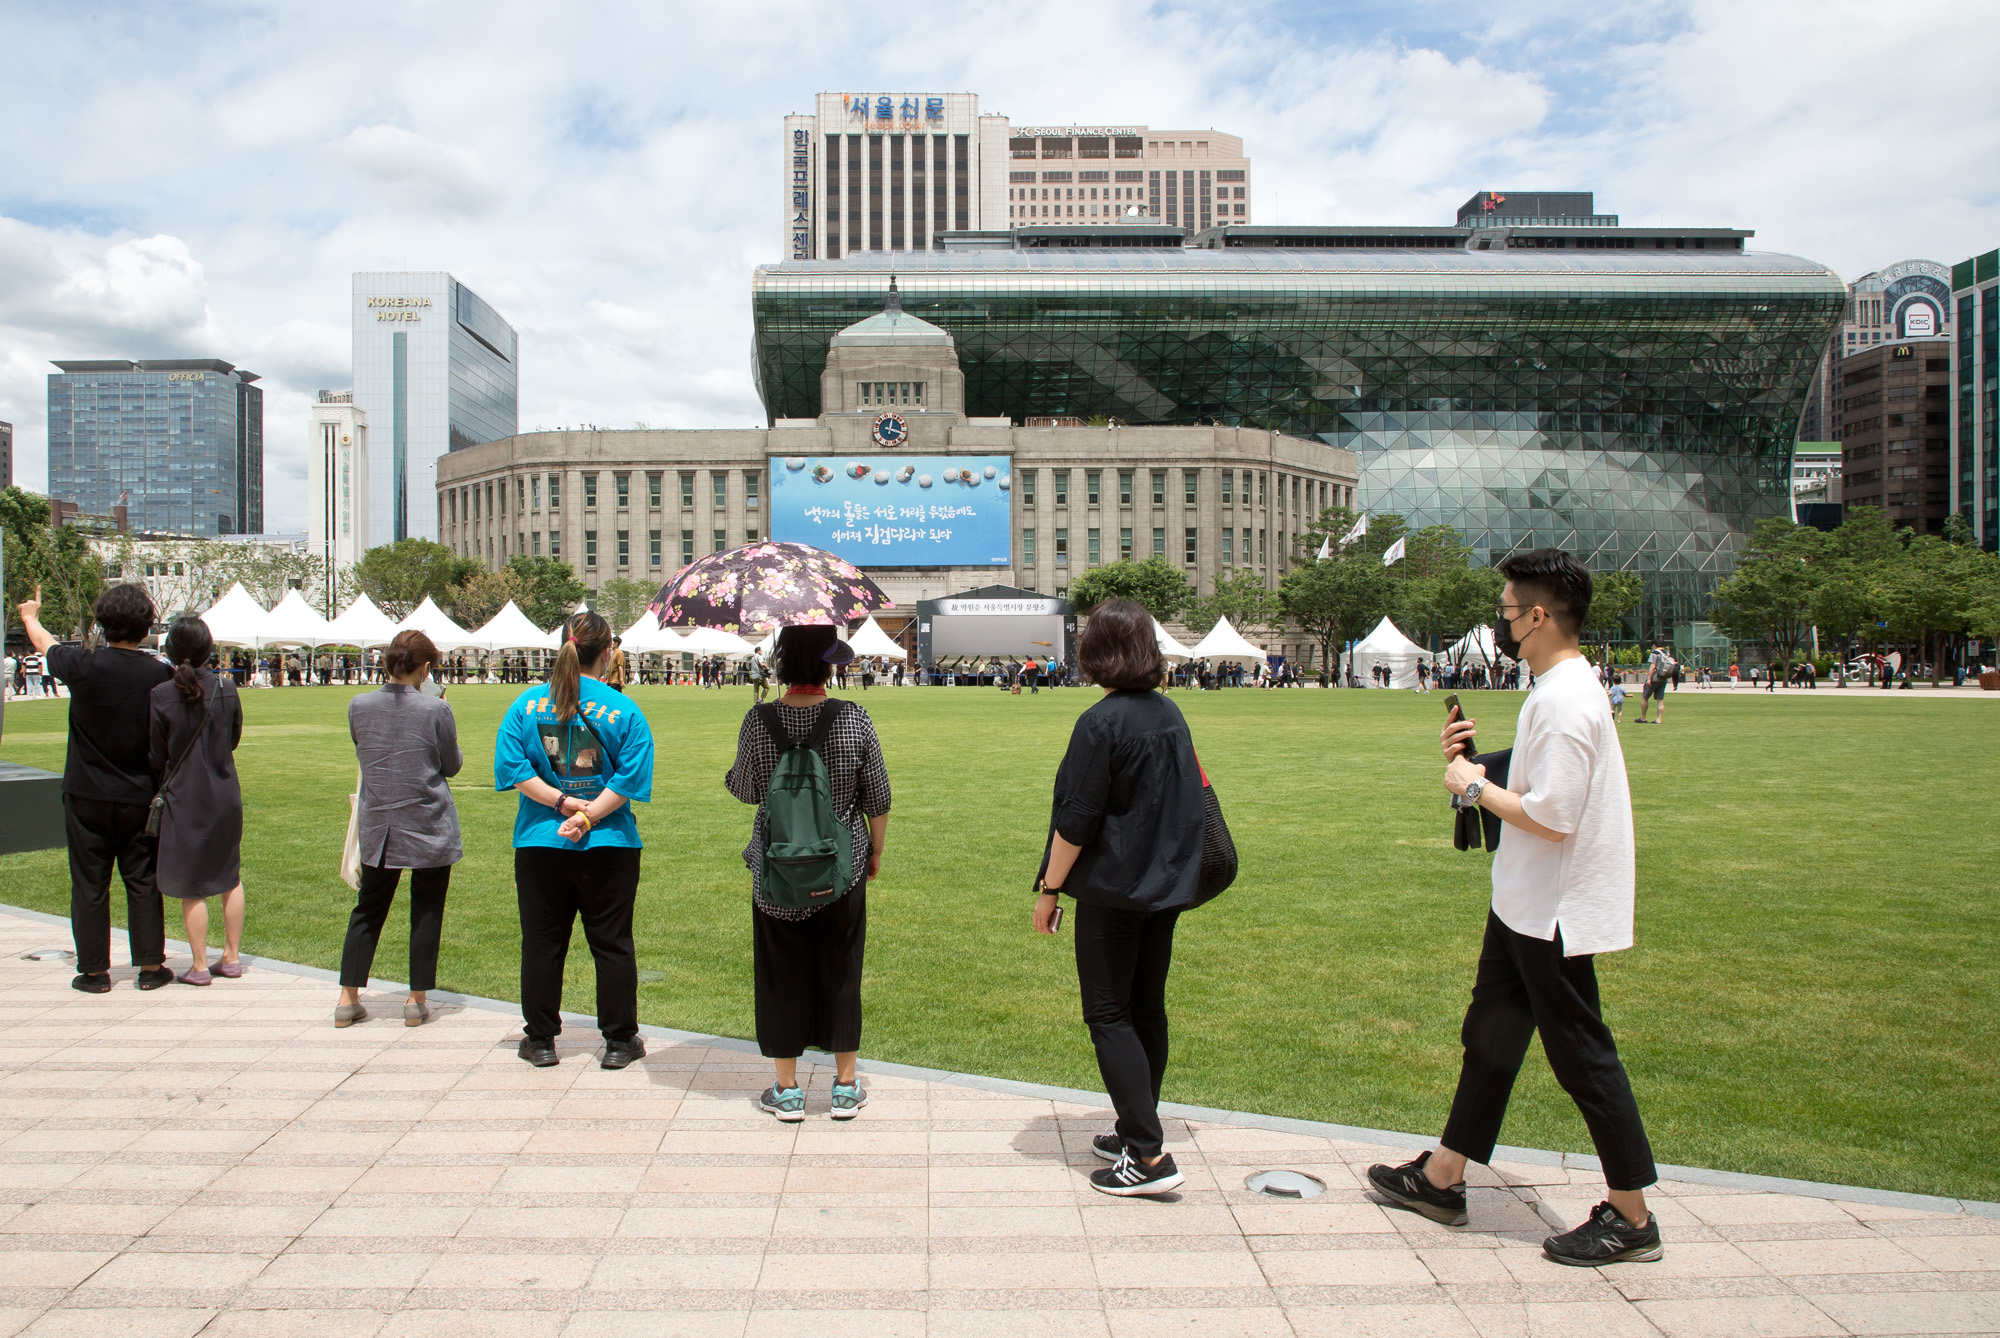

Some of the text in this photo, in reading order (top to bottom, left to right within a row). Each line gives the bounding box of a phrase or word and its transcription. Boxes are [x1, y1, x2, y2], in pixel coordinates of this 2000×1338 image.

[850, 96, 945, 118] 서울신문
[864, 120, 926, 130] seoul.co.kr
[1034, 127, 1063, 136] SEOUL
[1066, 127, 1103, 136] FINANCE
[1105, 127, 1137, 136] CENTER
[1482, 200, 1496, 210] SK
[367, 296, 432, 307] KOREANA
[376, 311, 421, 321] HOTEL
[168, 372, 204, 381] OFFICIA
[804, 500, 977, 527] 냇가의 돌들은 서로 거리를 두었음에도
[832, 524, 952, 545] 이어져 징검다리가 된다
[983, 603, 1024, 612] 서울특별시장
[526, 697, 621, 724] FRTIC
